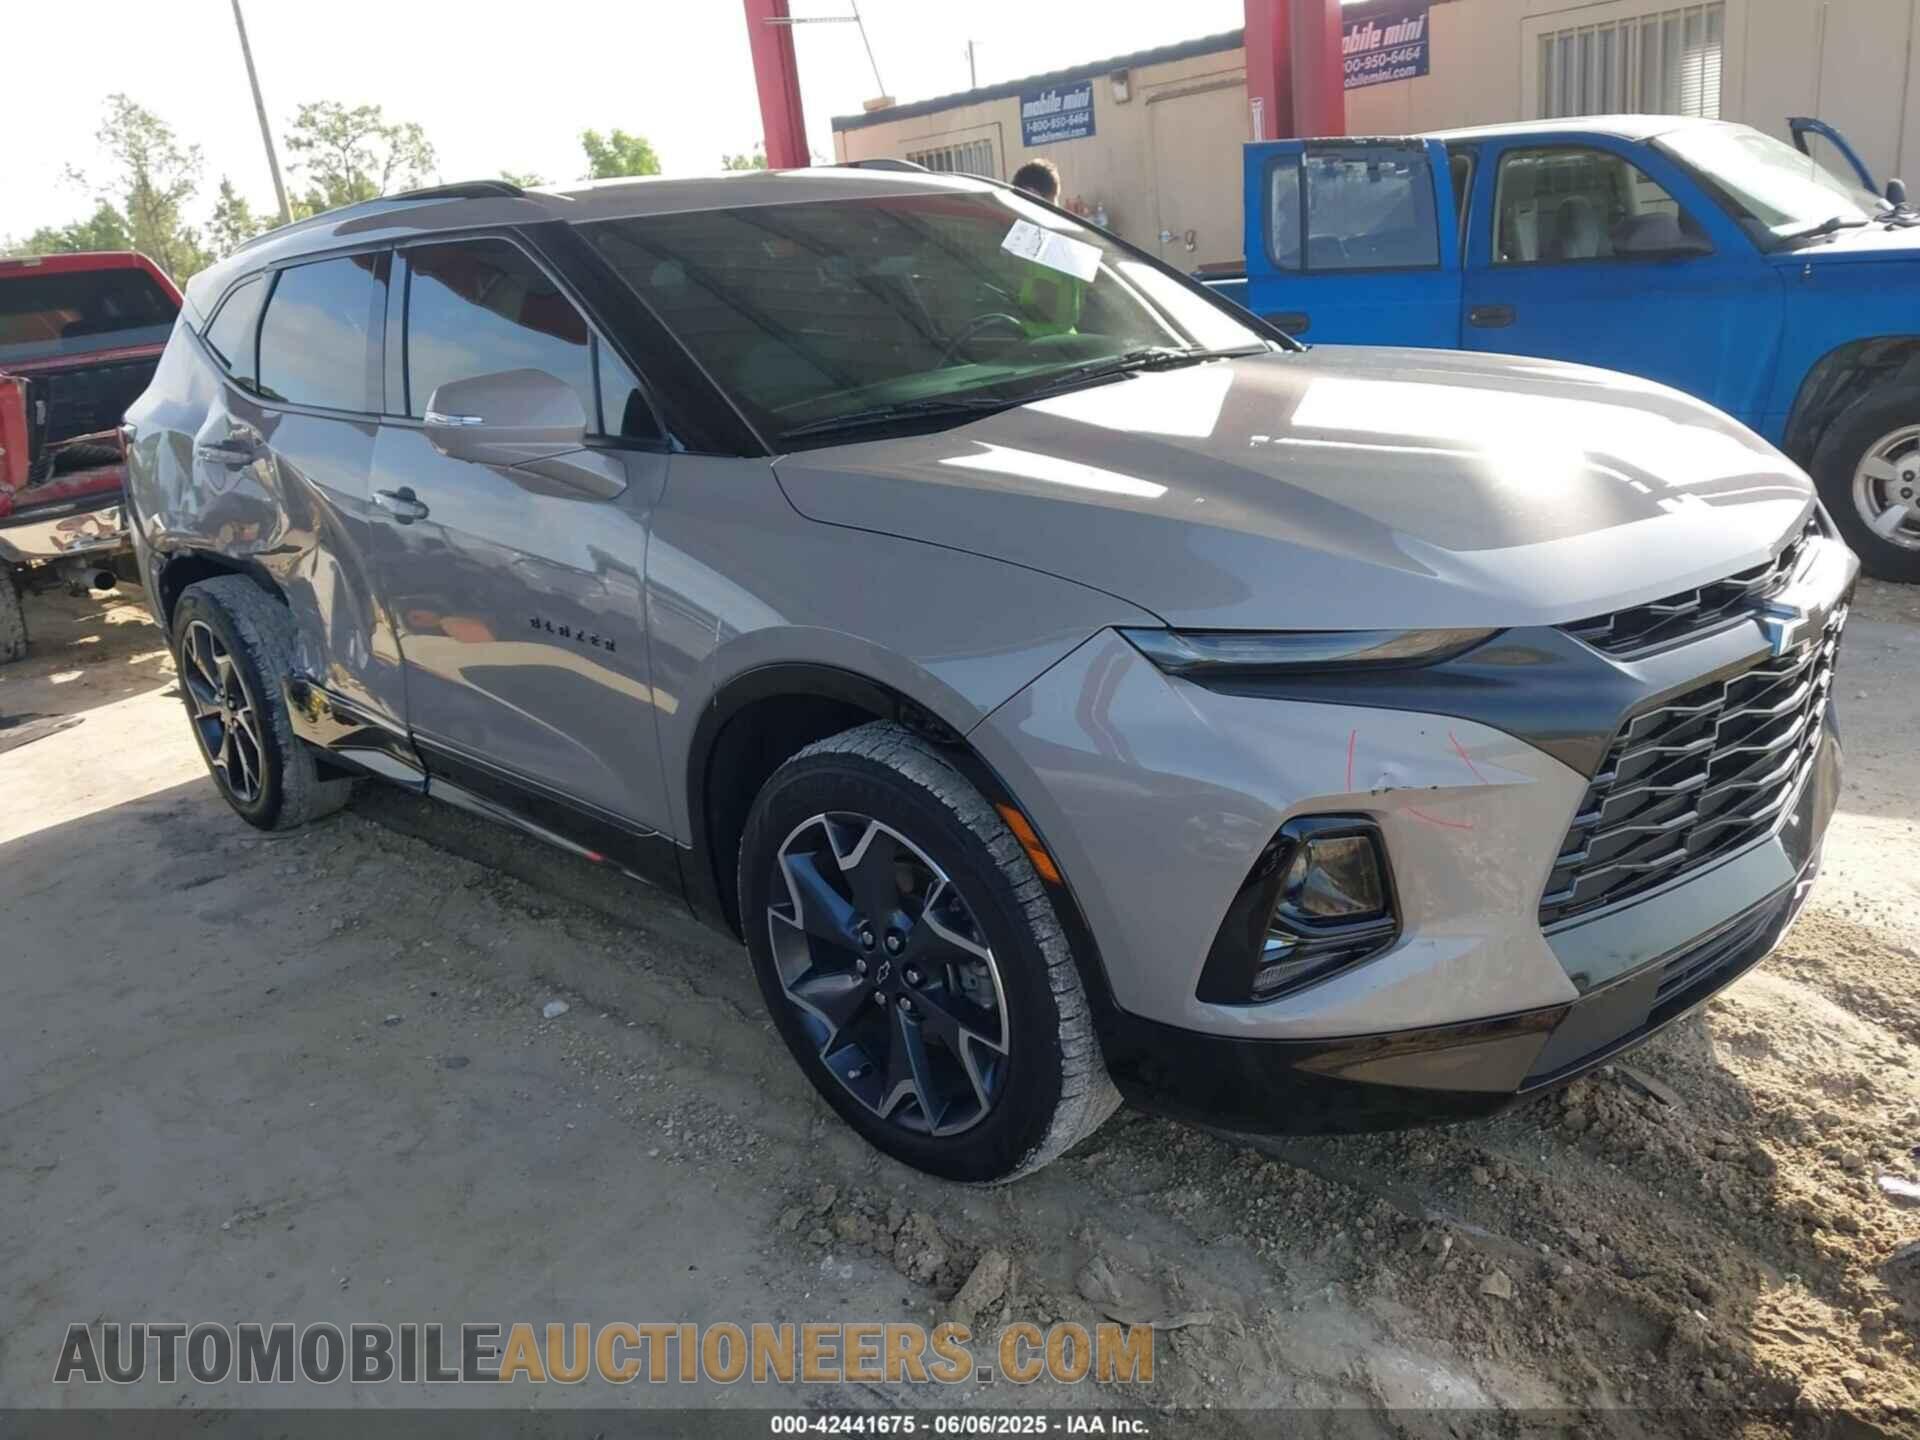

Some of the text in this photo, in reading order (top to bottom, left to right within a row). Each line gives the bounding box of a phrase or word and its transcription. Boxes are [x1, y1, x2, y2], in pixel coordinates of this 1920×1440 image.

[1343, 14, 1424, 54] obile mini
[1344, 46, 1421, 73] 00-950-6464
[1344, 66, 1416, 88] obilemini.com
[1022, 87, 1090, 118] mobile mini
